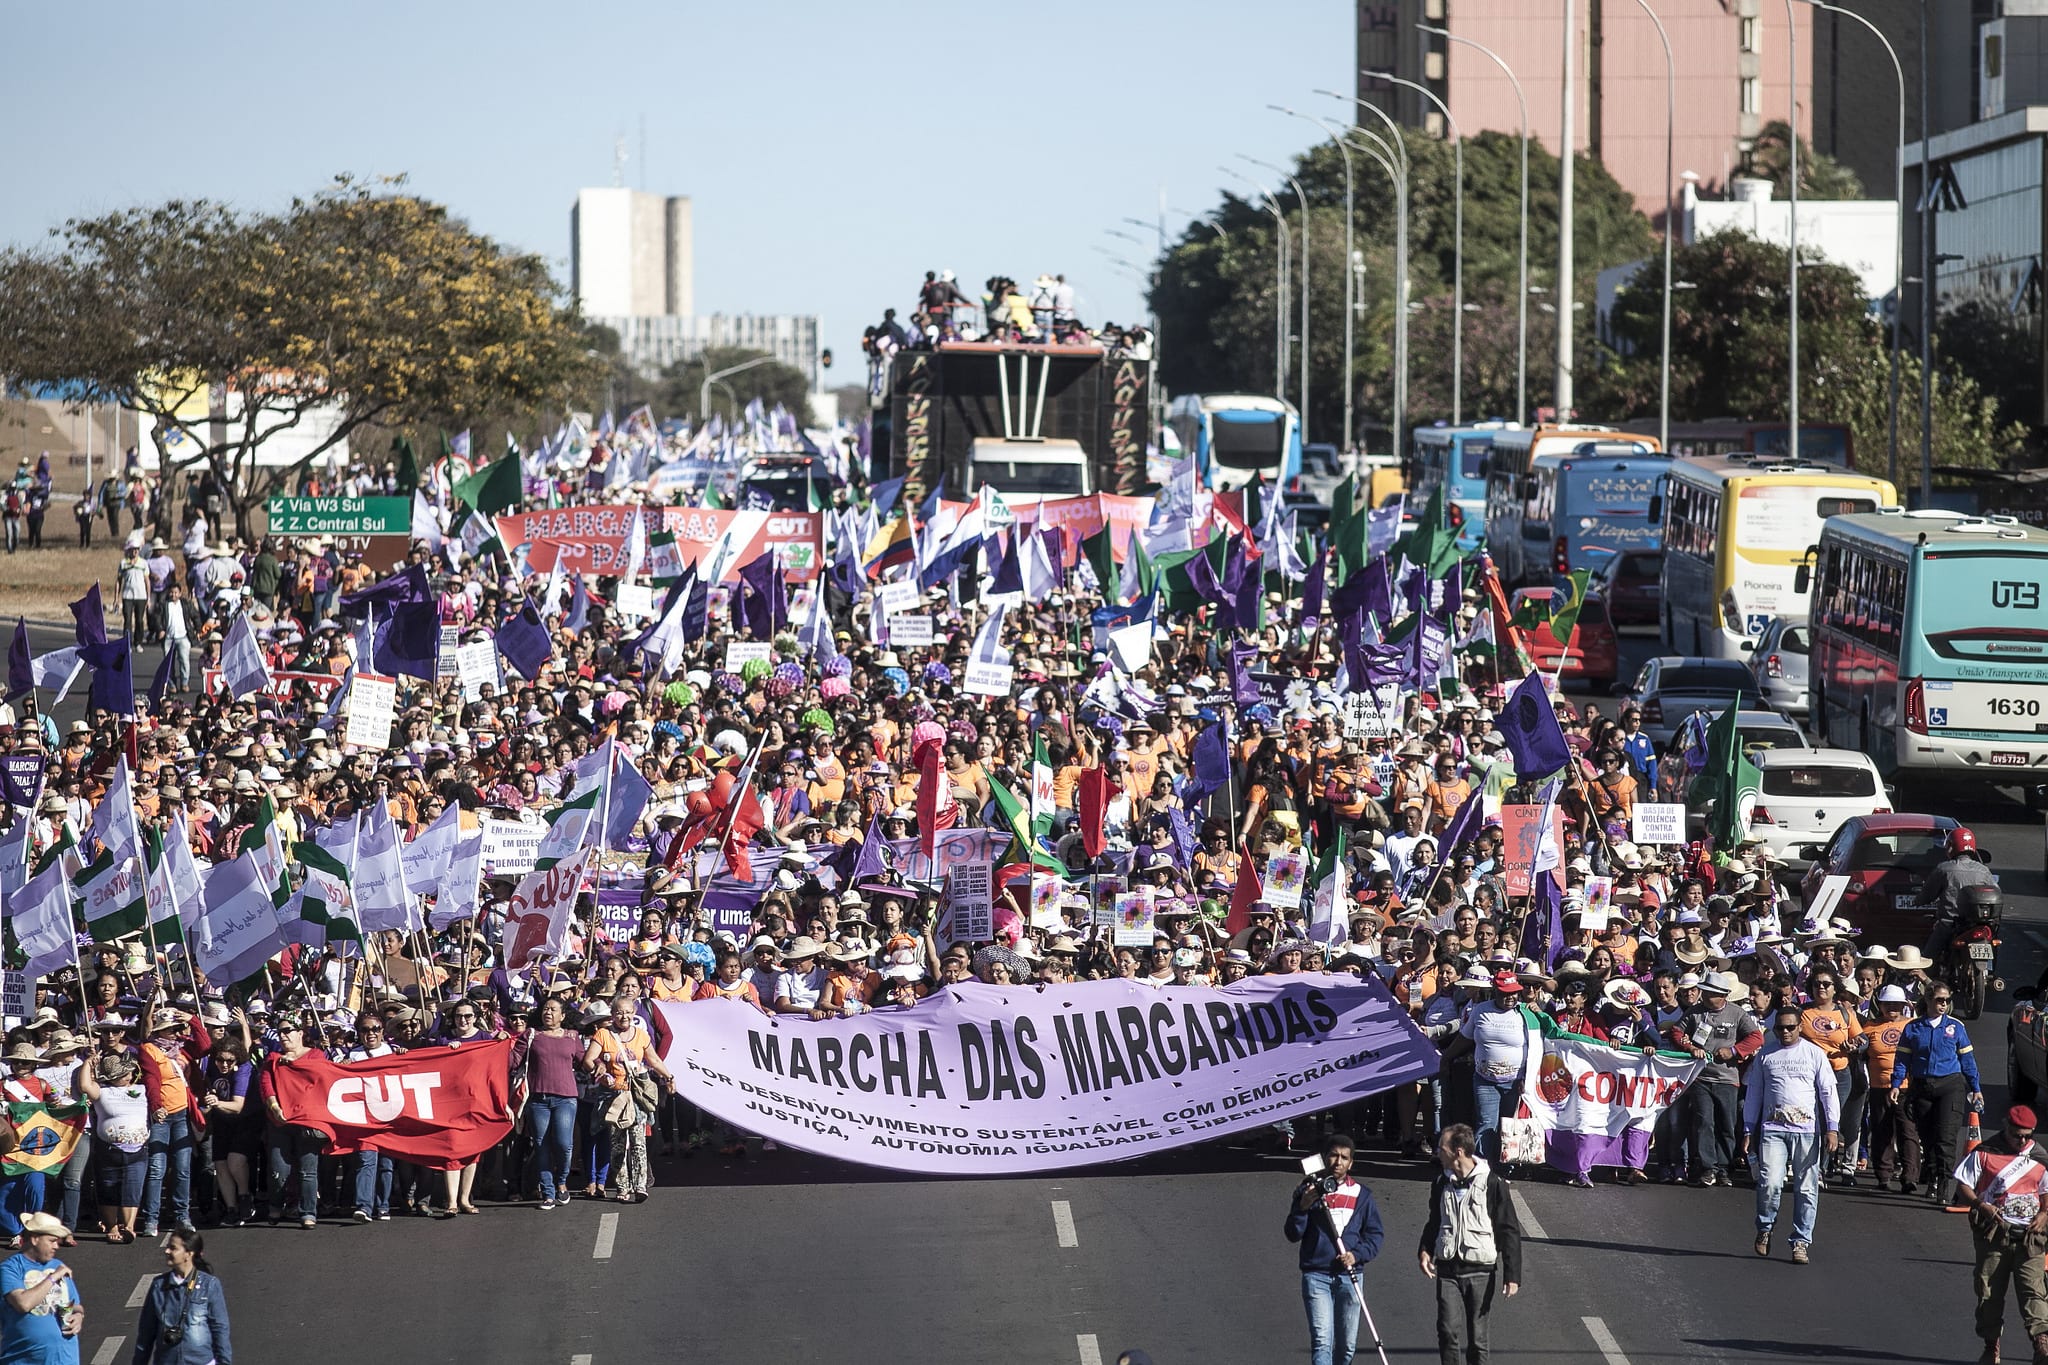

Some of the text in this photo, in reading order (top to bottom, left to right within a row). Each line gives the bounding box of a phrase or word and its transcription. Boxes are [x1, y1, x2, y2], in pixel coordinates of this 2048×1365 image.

[289, 499, 365, 512] Via W3 Sul
[289, 517, 385, 531] Z. Central Sul
[524, 510, 808, 542] MARGARIDAS CUT
[352, 536, 371, 550] TV
[558, 543, 586, 557] DO
[1744, 580, 1782, 591] Pioneira
[1992, 580, 2039, 609] UTB
[1985, 667, 2032, 681] Transporte
[1987, 698, 2040, 717] 1630
[8, 761, 39, 772] MARCHA
[1643, 806, 1675, 815] BASTA DE
[1641, 813, 1676, 824] VIOLÊNCIA
[502, 839, 542, 849] EM DEFES
[518, 849, 530, 857] DA
[719, 908, 751, 923] uma
[746, 989, 1338, 1101] MARCHA DAS MARGARIDAS
[326, 1071, 443, 1125] CUT
[687, 1048, 1381, 1141] POR DESENVOLVIMENTO SUSTENTÁVEL COM DEMOCRACIA,
[745, 1090, 1322, 1157] JUSTIÇA, AUTONOMIA IGUALDADE E LIBERDADE
